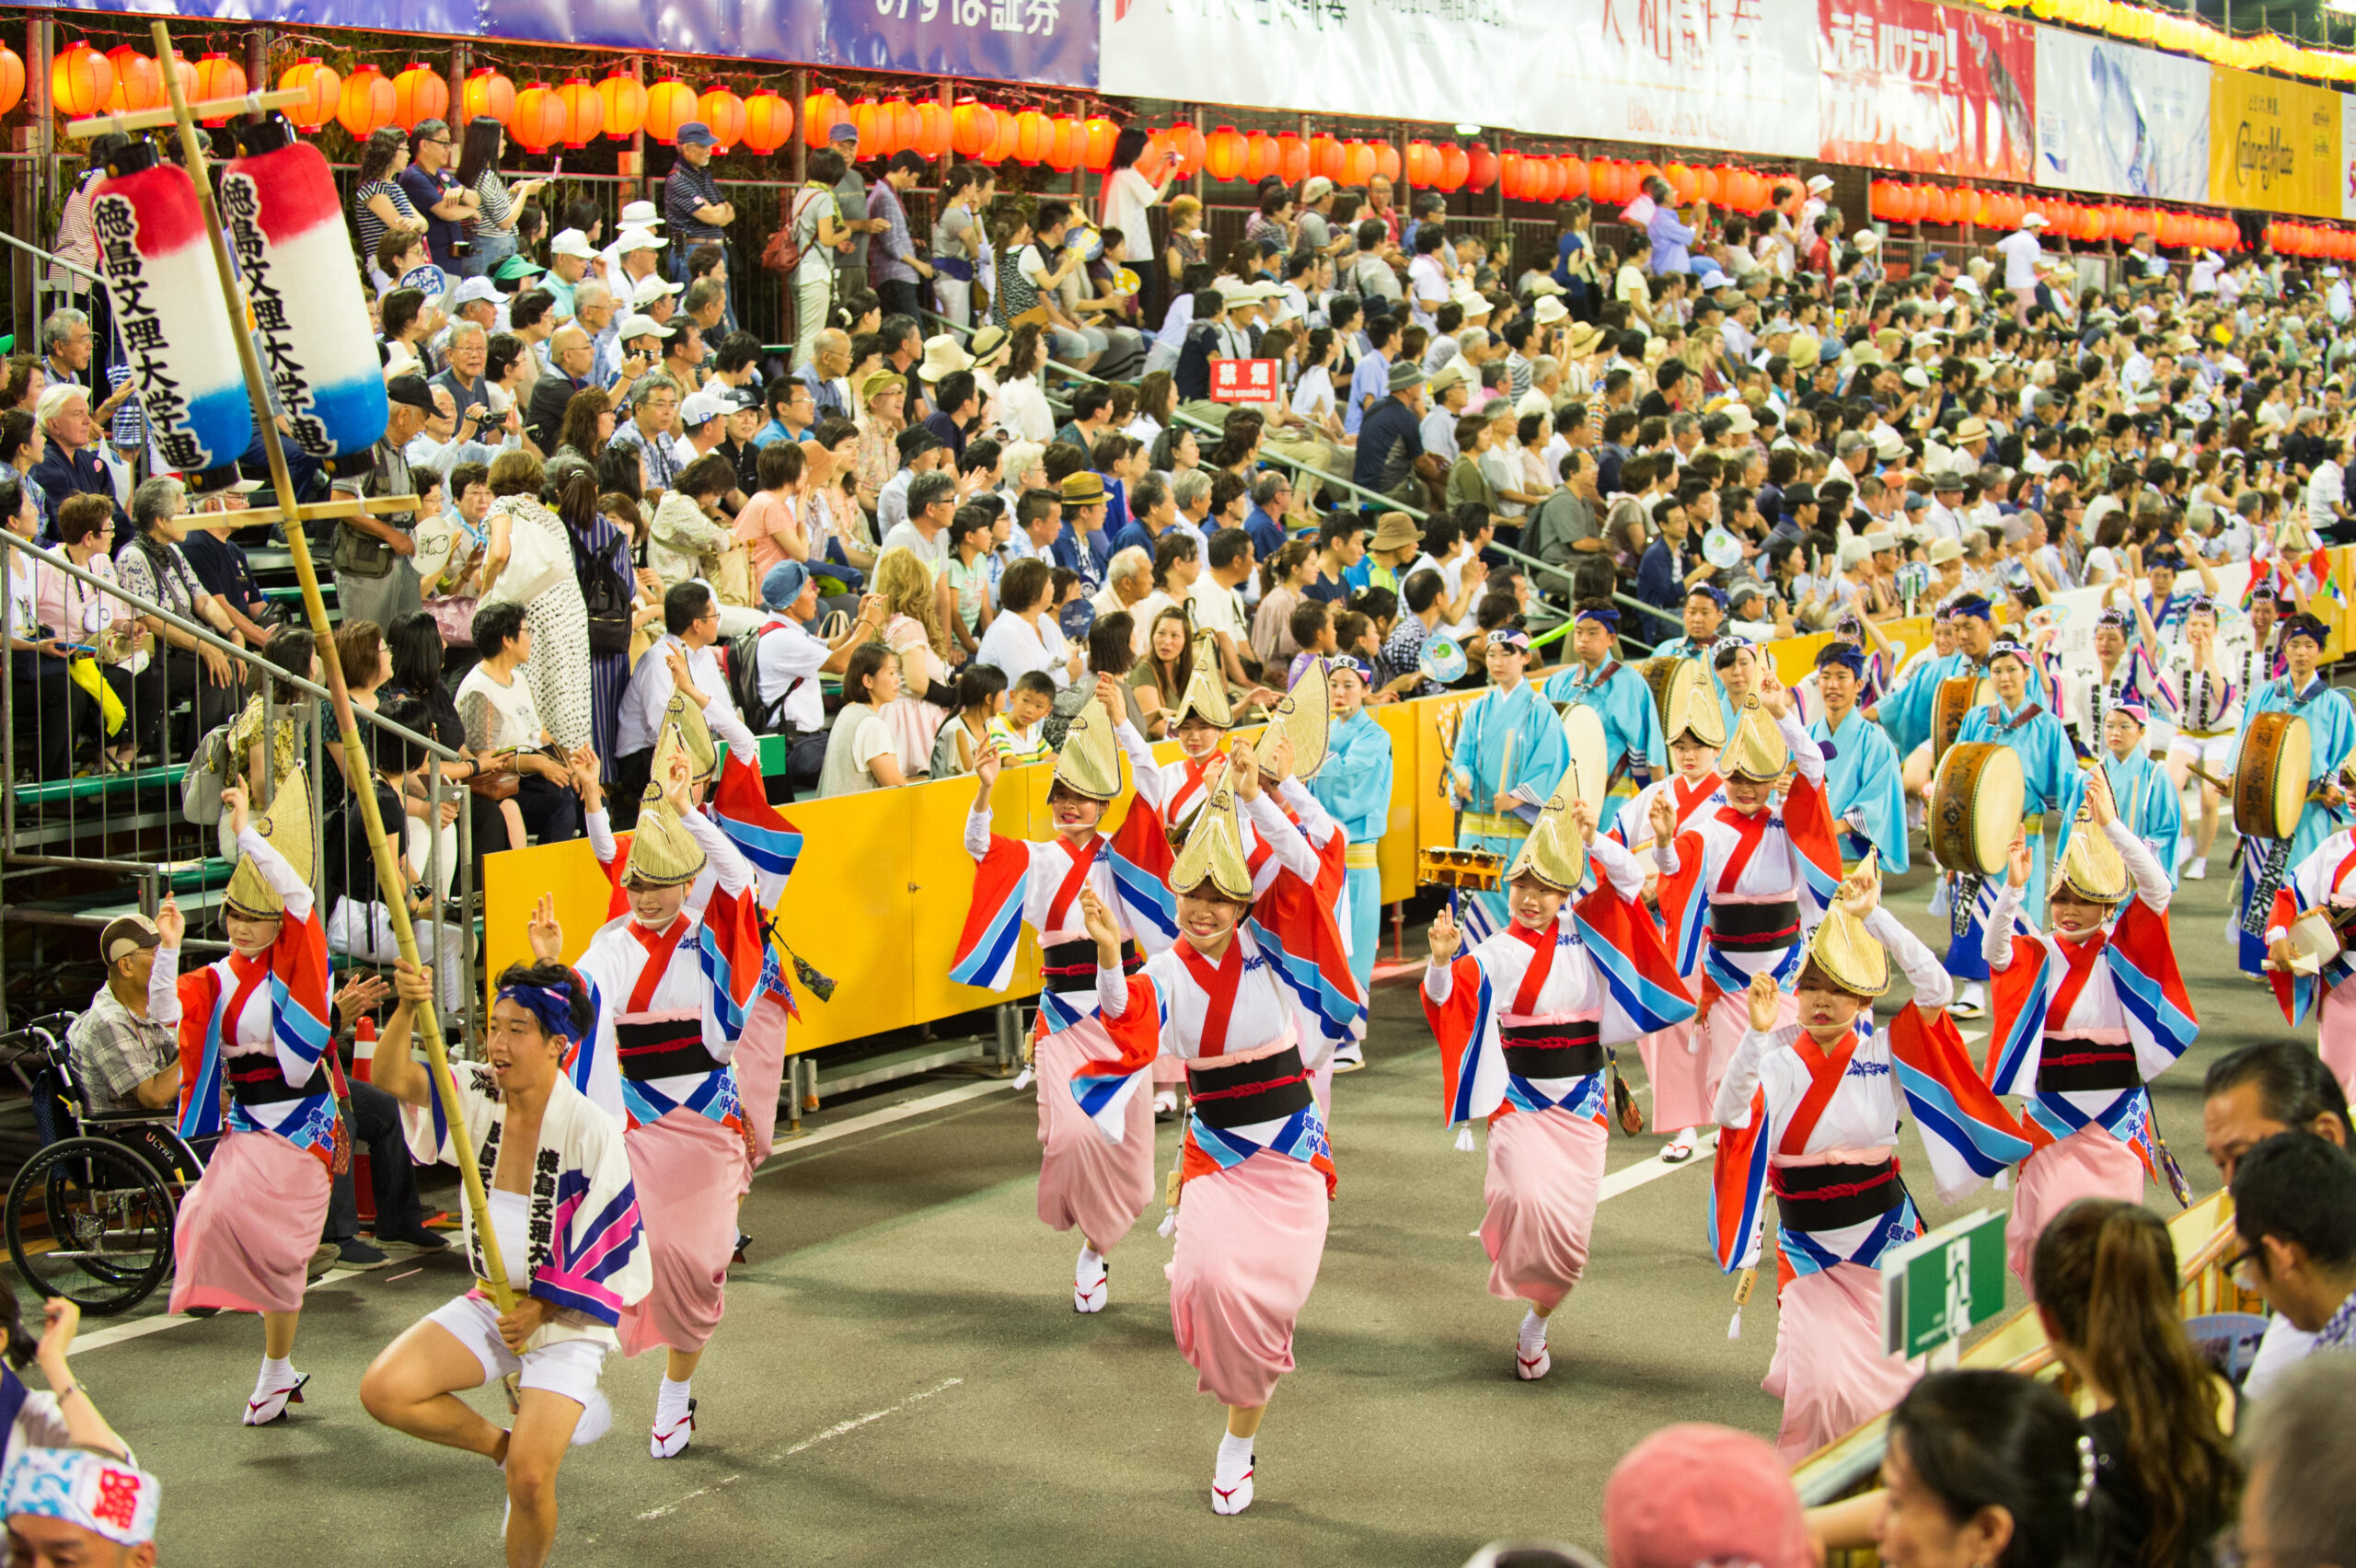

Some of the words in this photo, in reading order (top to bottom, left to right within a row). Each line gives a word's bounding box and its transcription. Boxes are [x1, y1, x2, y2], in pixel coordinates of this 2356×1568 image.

[92, 196, 206, 467] 徳島文理大学連
[1218, 362, 1269, 386] 禁煙
[1216, 387, 1234, 398] Non
[1235, 387, 1271, 400] smoking
[145, 1131, 176, 1164] ULTRA
